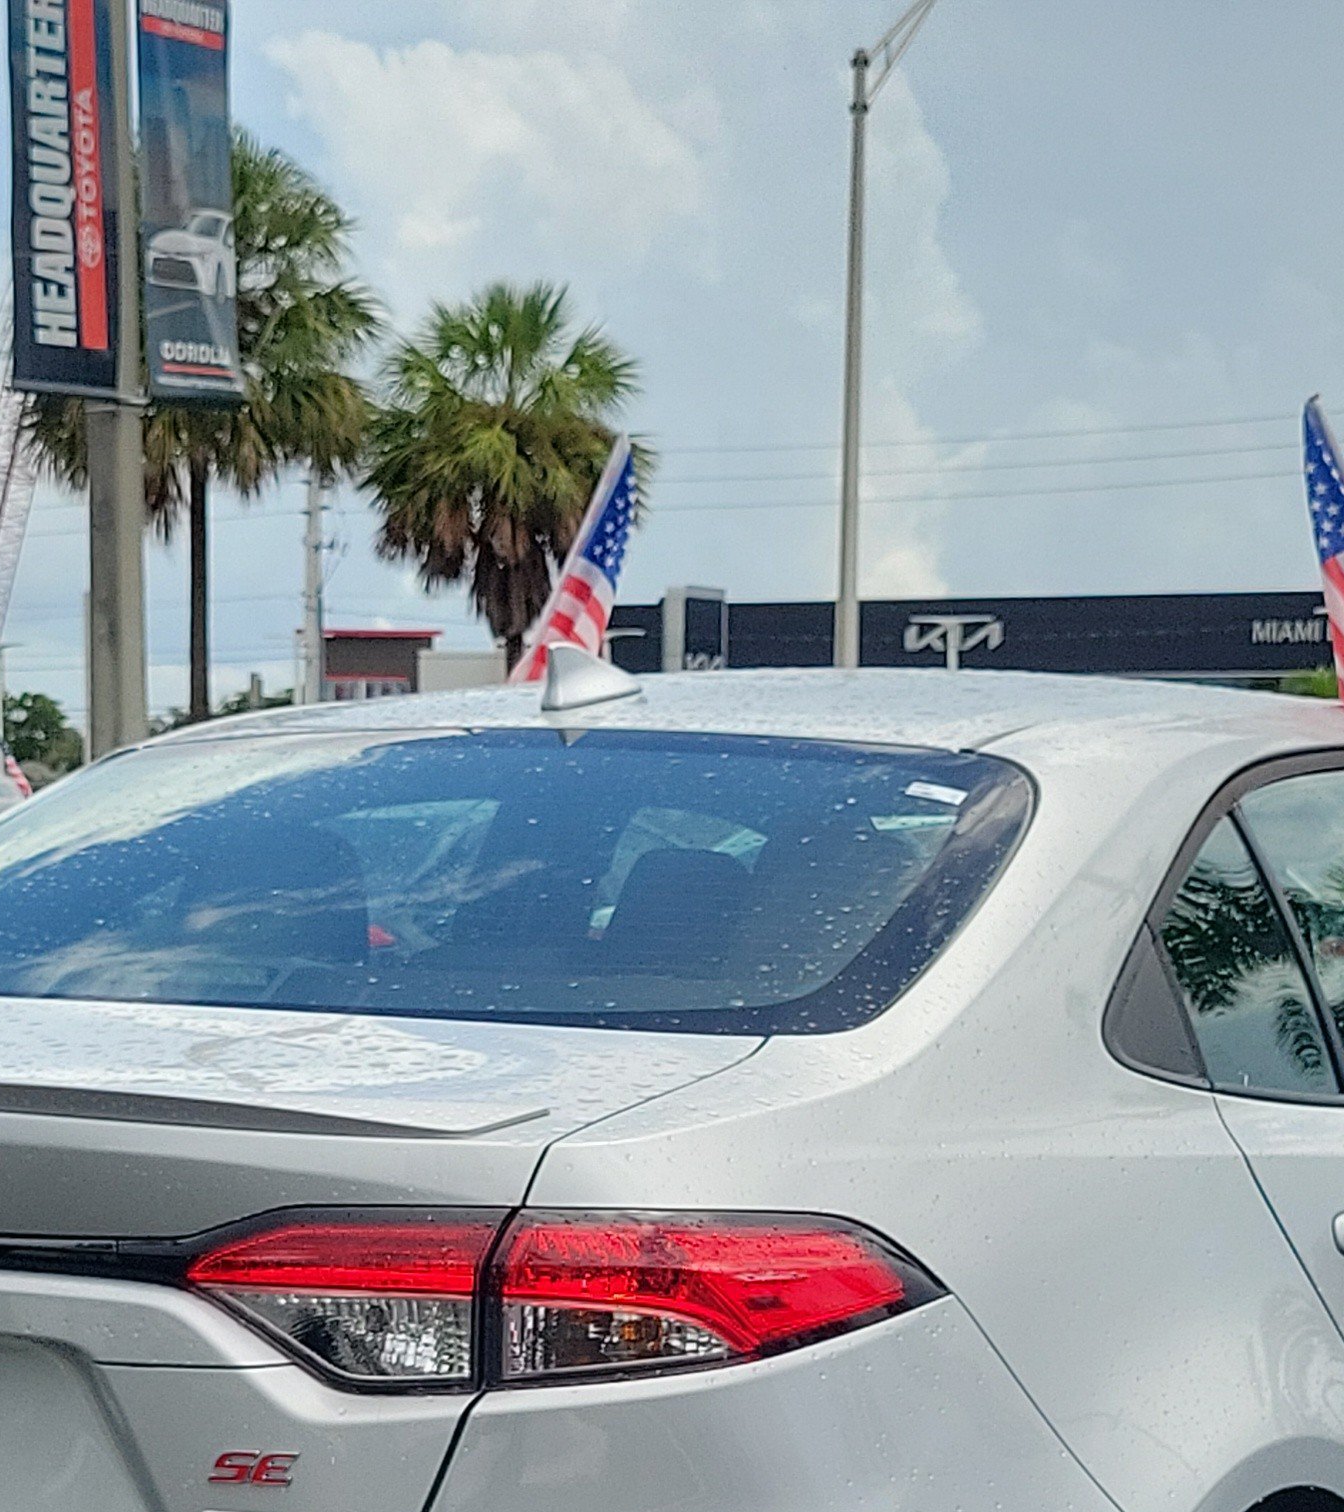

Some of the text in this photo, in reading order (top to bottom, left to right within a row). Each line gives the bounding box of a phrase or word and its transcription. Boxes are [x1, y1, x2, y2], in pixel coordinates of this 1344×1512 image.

[73, 88, 98, 220] TOYOTA
[1252, 619, 1324, 643] MIAMI
[208, 1449, 301, 1486] SE
